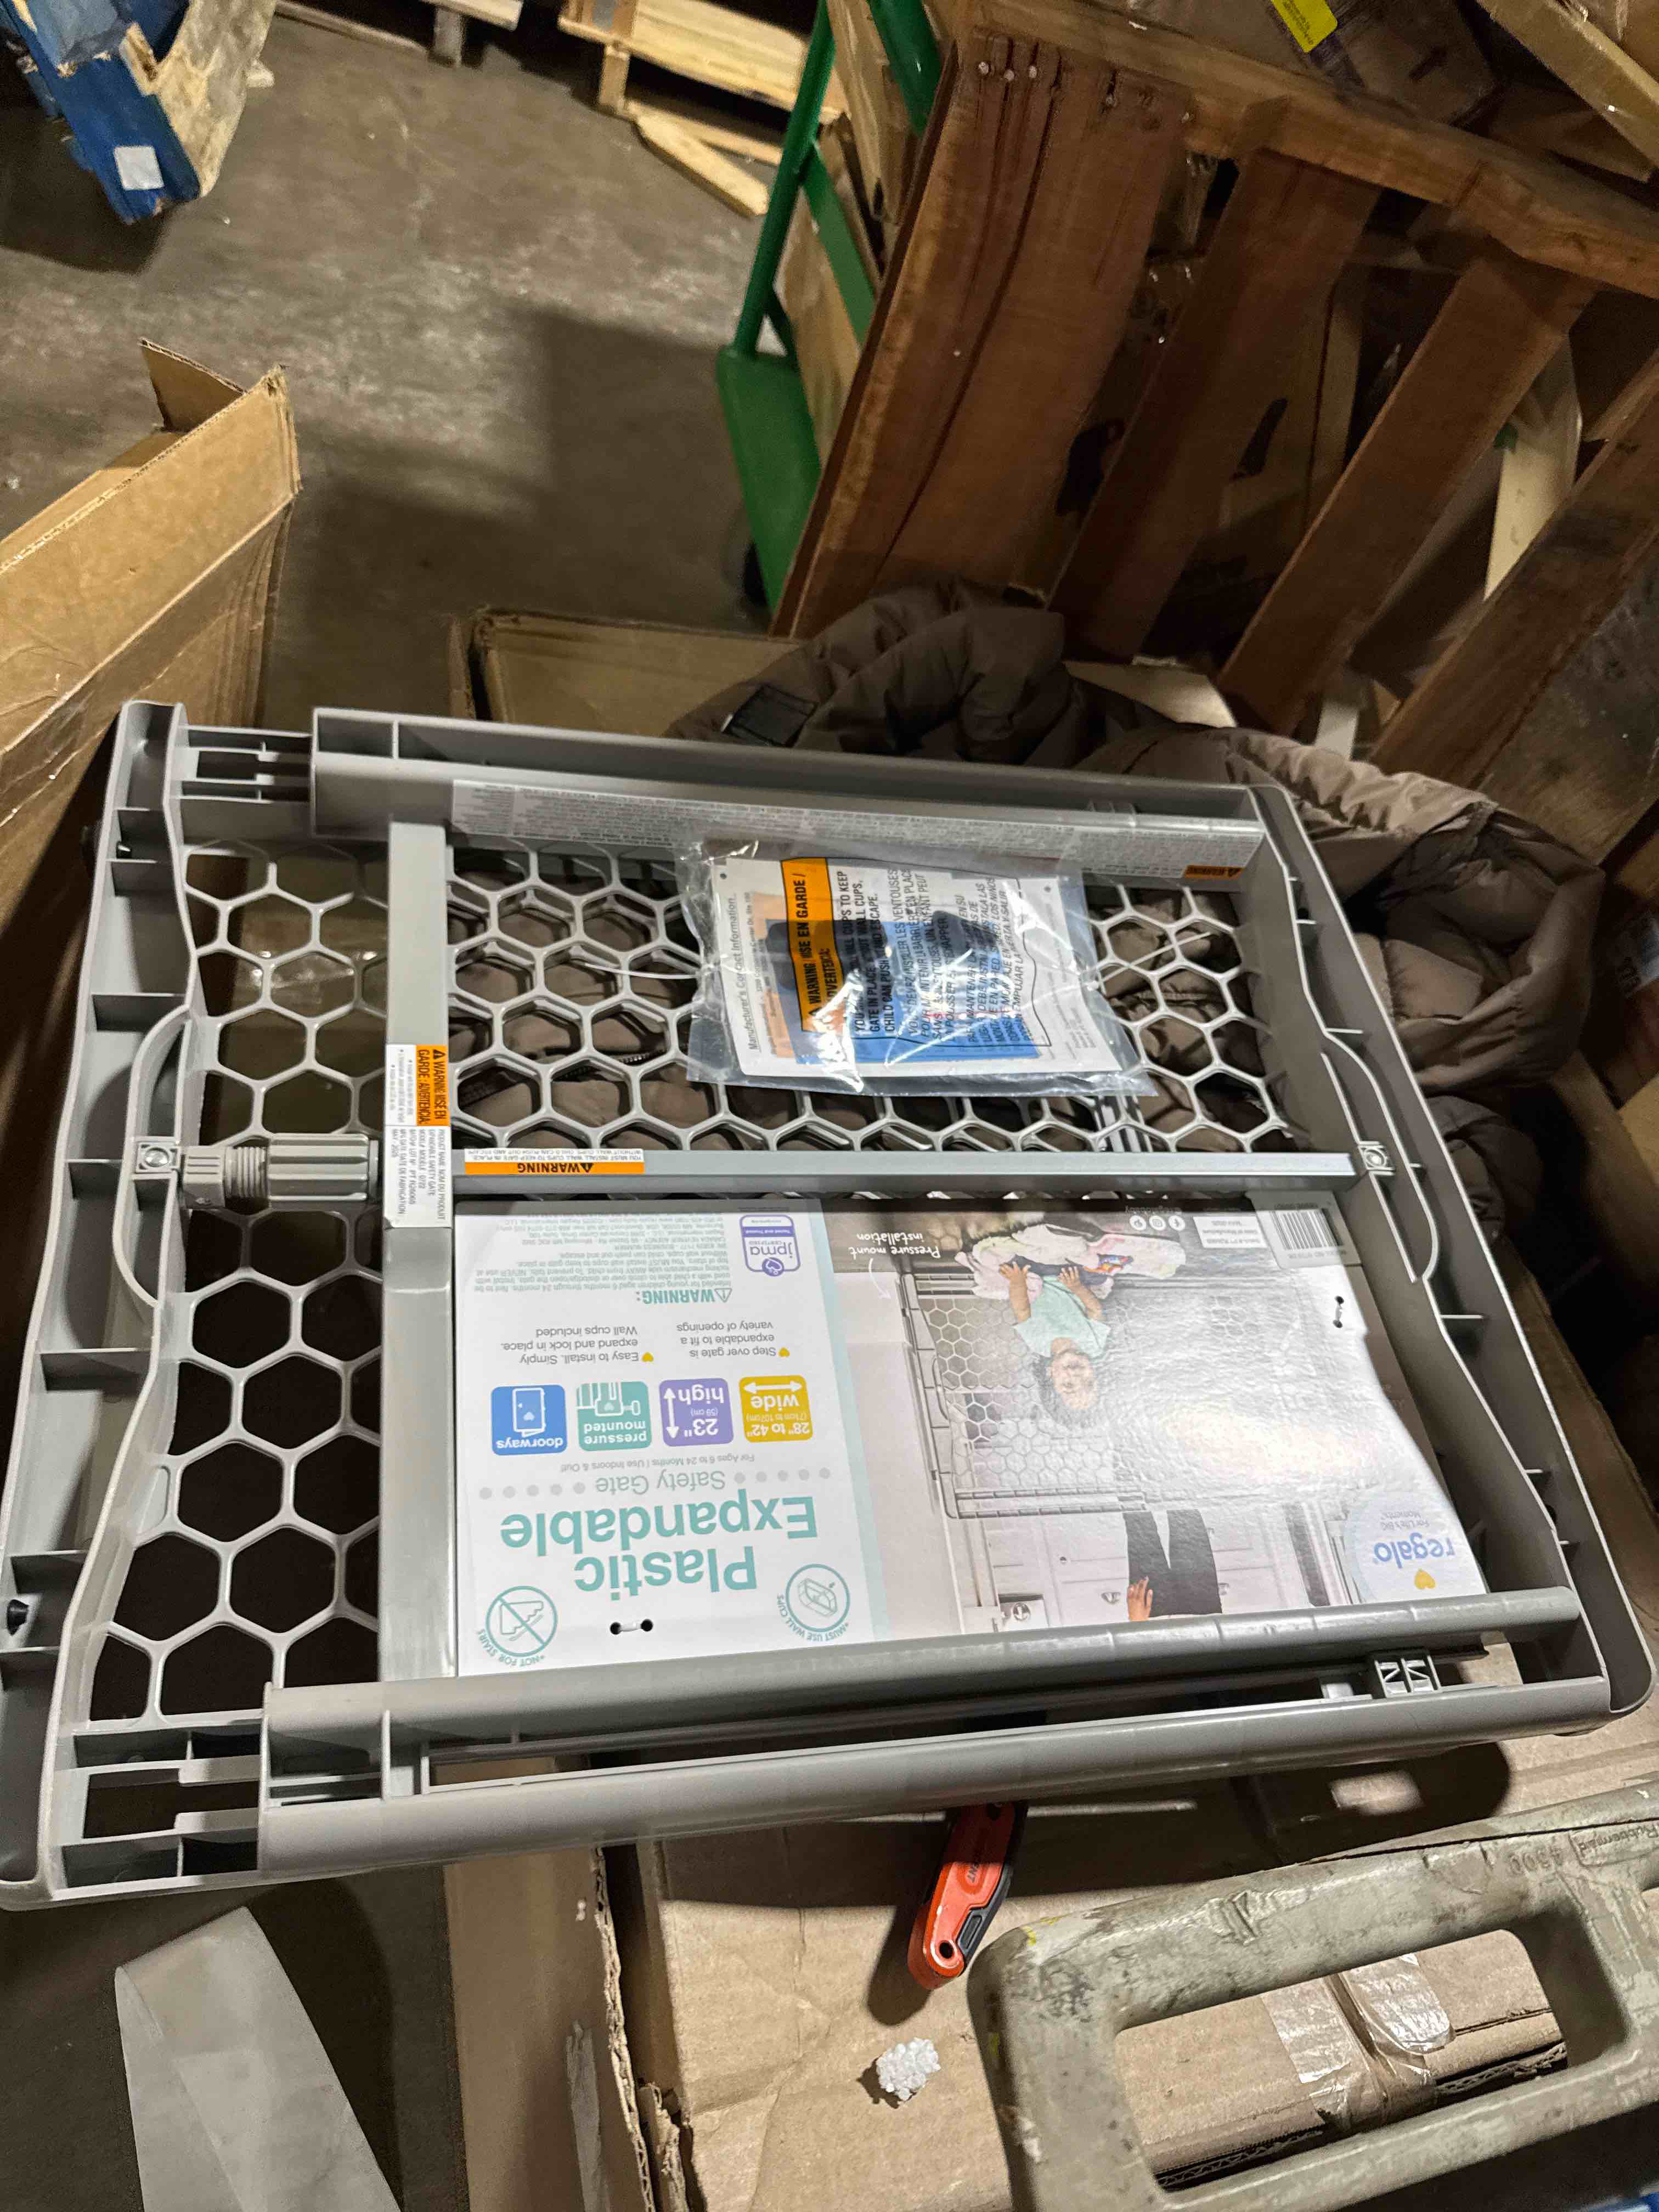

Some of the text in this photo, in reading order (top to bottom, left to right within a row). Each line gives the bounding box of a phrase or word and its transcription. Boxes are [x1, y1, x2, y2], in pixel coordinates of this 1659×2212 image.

[837, 871, 849, 891] KEEP
[915, 873, 928, 893] PEUT
[793, 880, 808, 918] GARDE
[840, 895, 850, 906] TO
[888, 870, 903, 921] VENTOUSES
[797, 923, 809, 937] EN
[895, 923, 906, 938] LES
[727, 898, 758, 1049] Manufacturer's Information
[879, 960, 895, 1031] CHILD CAN PUSH
[867, 998, 880, 1031] GATE IN
[854, 1013, 865, 1031] YOU
[419, 1049, 431, 1077] GARDE
[435, 1110, 447, 1119] EN
[517, 1163, 580, 1173] WARNING
[856, 1232, 924, 1245] installation
[750, 1242, 793, 1259] jpma
[848, 1246, 941, 1260] Pressure mount
[636, 1290, 715, 1304] WARNING:
[535, 1325, 637, 1338] Wall cups included
[676, 1321, 773, 1333] variety of openings
[500, 1339, 637, 1351] expand and lock in place.
[690, 1336, 699, 1346] fit
[703, 1336, 712, 1345] to
[715, 1333, 775, 1345] expandable
[520, 1351, 639, 1364] Easy to install. Simply
[689, 1346, 776, 1359] Step over gate is
[678, 1384, 724, 1405] high
[750, 1395, 799, 1412] wide
[584, 1421, 646, 1434] mounted
[684, 1418, 719, 1437] 23"
[746, 1422, 809, 1437] 28" to 42"
[496, 1437, 563, 1450] doorways
[584, 1431, 647, 1445] pressure
[653, 1458, 684, 1466] Months
[717, 1453, 739, 1463] Ages
[741, 1454, 754, 1462] For
[592, 1461, 624, 1470] Indoors
[595, 1469, 726, 1496] Safety Gate
[500, 1488, 817, 1556] Expandable
[1374, 1532, 1455, 1569] regalo
[574, 1546, 757, 1601] Plastic
[777, 1595, 788, 1617] CUPS
[786, 1615, 805, 1637] WALL
[807, 1633, 823, 1642] USE
[499, 1654, 517, 1666] FOR
